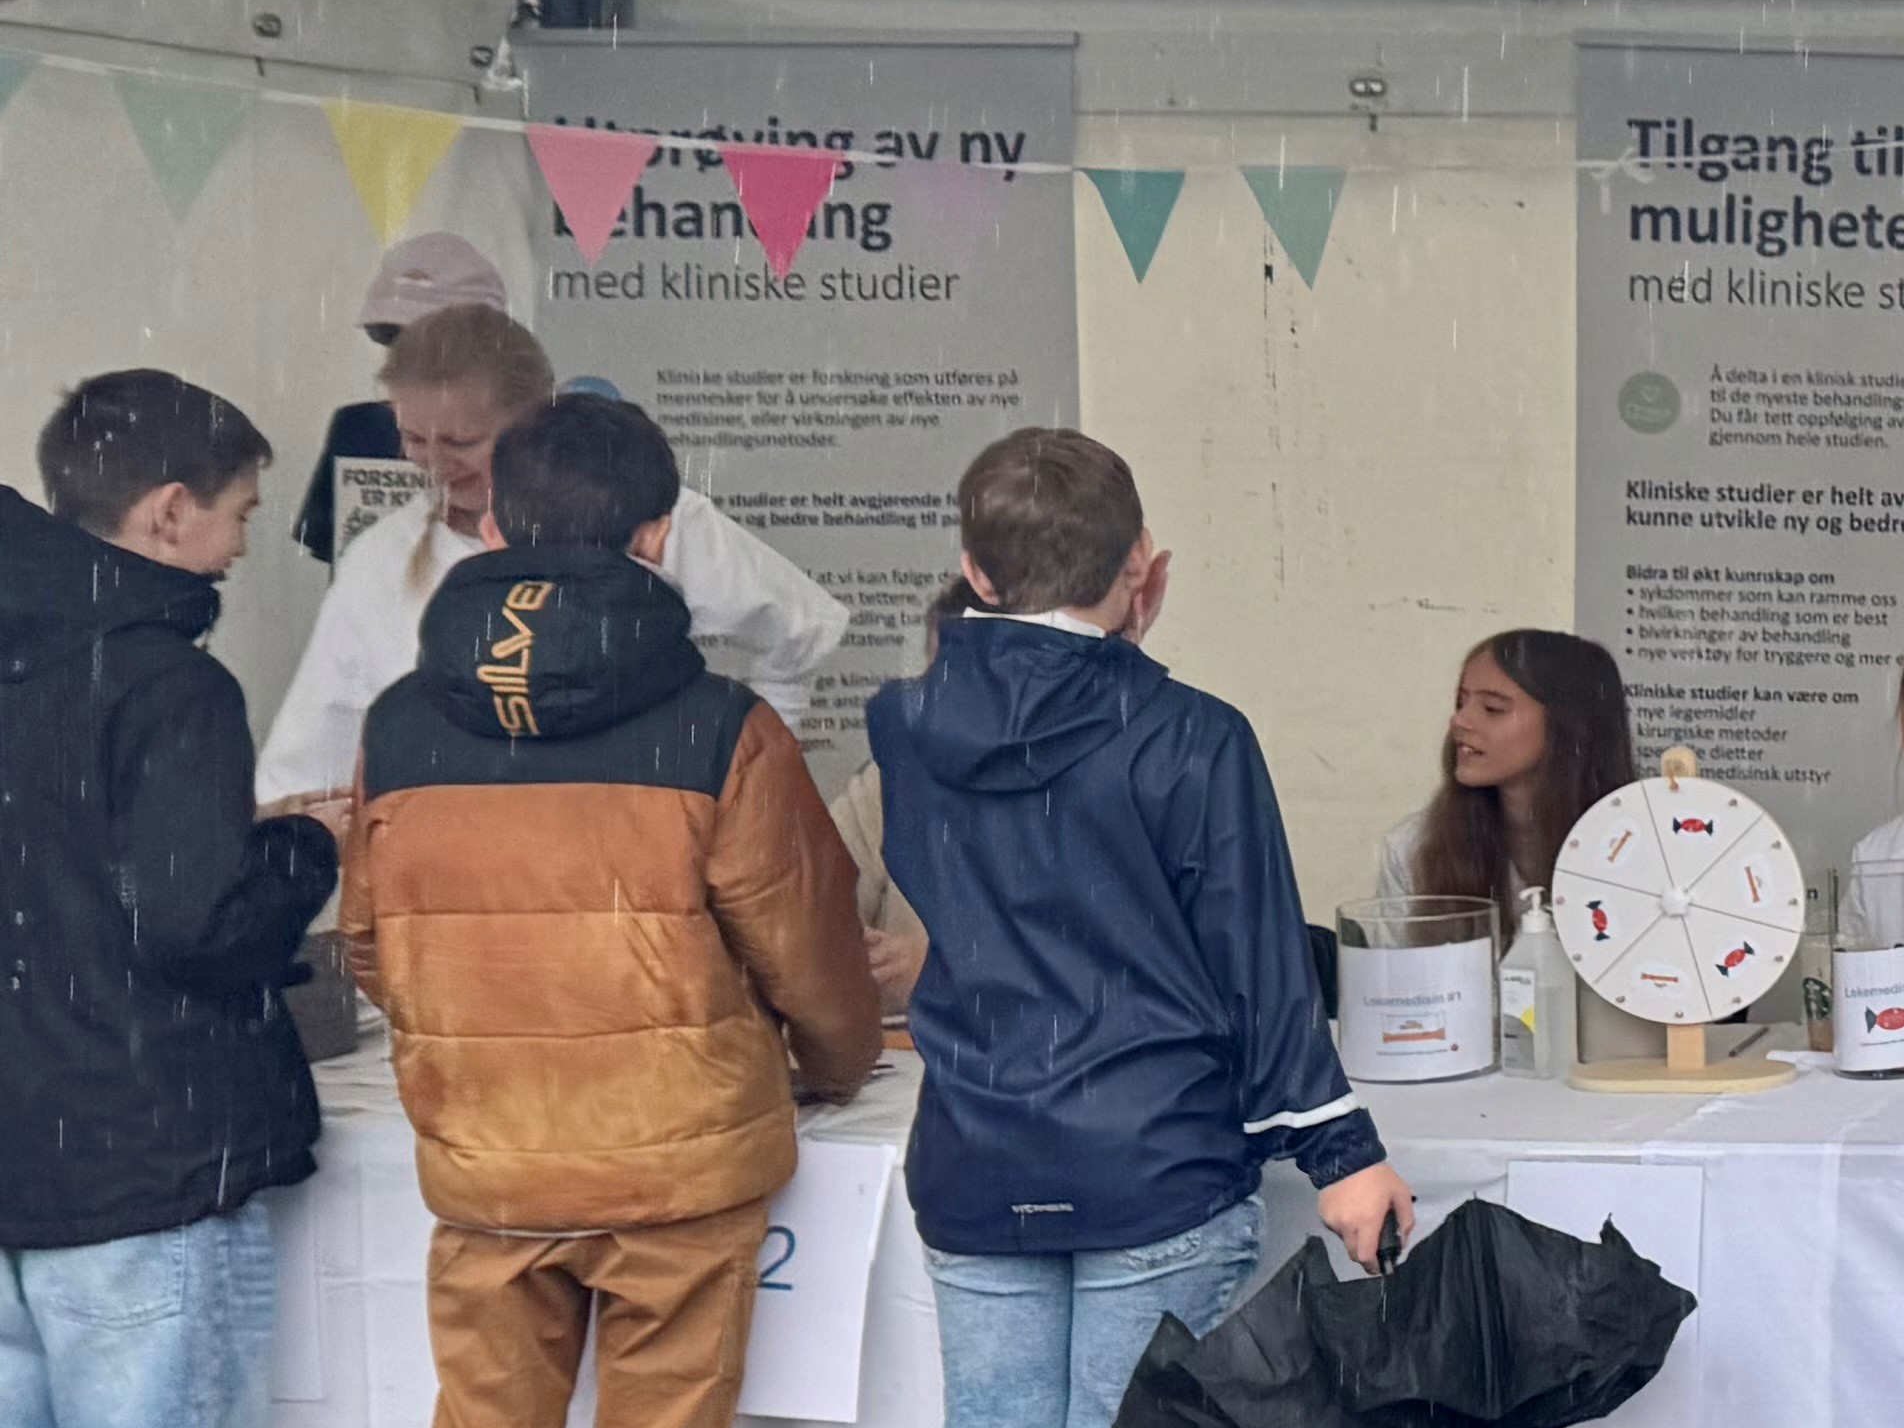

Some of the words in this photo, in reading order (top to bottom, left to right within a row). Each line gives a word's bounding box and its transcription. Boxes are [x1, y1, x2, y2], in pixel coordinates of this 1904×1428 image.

[874, 130, 940, 168] av
[961, 127, 1027, 182] ny
[1627, 117, 1835, 186] Tilgang
[1849, 127, 1904, 179] til
[552, 266, 644, 302] med
[661, 262, 806, 303] kliniske
[819, 264, 961, 303] studier
[1628, 272, 1714, 307] med
[1726, 269, 1866, 310] kliniske
[657, 370, 722, 386] Kliniske
[727, 370, 783, 386] studier
[788, 373, 805, 386] er
[813, 370, 888, 389] forskning
[894, 373, 930, 386] som
[934, 370, 994, 387] utføres
[998, 369, 1019, 389] på
[1711, 363, 1723, 383] Å
[1726, 367, 1769, 385] delta
[1782, 372, 1803, 385] en
[1807, 369, 1855, 387] klinisk
[657, 391, 751, 407] mennesker
[757, 391, 779, 406] for
[799, 392, 888, 407] undersøke
[893, 391, 961, 406] effekten
[966, 395, 984, 407] av
[1711, 388, 1730, 405] til
[1732, 389, 1752, 405] de
[1756, 392, 1808, 410] nyeste
[792, 413, 883, 429] virkningen
[1711, 407, 1733, 425] Du
[1737, 406, 1759, 425] får
[1764, 409, 1793, 426] tett
[1796, 410, 1883, 432] oppfølging
[668, 432, 838, 450] ehandlingsmetoder.
[1709, 429, 1782, 448] gjennom
[1786, 430, 1822, 448] hele
[1825, 431, 1888, 450] studien.
[728, 492, 786, 508] studier
[790, 494, 808, 508] er
[812, 491, 845, 508] helt
[850, 492, 942, 511] avgjørende
[1626, 479, 1711, 503] Kliniske
[1717, 482, 1796, 505] studier
[1801, 489, 1825, 506] er
[1831, 484, 1874, 508] helt
[770, 511, 820, 527] bedre
[823, 510, 918, 529] behandling
[1626, 505, 1694, 528] kunne
[1700, 508, 1778, 531] utvikle
[1783, 514, 1809, 536] ny
[1816, 515, 1843, 537] og
[1626, 564, 1670, 583] Bidra
[1673, 565, 1690, 582] til
[1692, 567, 1721, 584] økt
[1725, 567, 1805, 590] kunnskap
[1808, 572, 1835, 586] om
[1639, 585, 1734, 606] sykdommer
[1738, 590, 1771, 604] som
[1777, 586, 1805, 604] kan
[1810, 590, 1866, 606] ramme
[1871, 593, 1898, 607] oss
[1699, 605, 1791, 628] behandling
[1795, 608, 1828, 625] som
[1833, 612, 1851, 625] er
[1854, 610, 1889, 627] best
[1639, 624, 1734, 646] bivirkninger
[1738, 628, 1758, 641] av
[1762, 626, 1851, 649] behandling
[1639, 647, 1667, 665] nye
[1737, 646, 1758, 662] for
[1764, 649, 1832, 670] tryggere
[1834, 652, 1856, 669] og
[1858, 653, 1893, 667] mer
[1624, 683, 1685, 700] Kliniske
[1690, 685, 1748, 702] studier
[1754, 686, 1783, 702] kan
[1787, 690, 1828, 704] være
[1832, 691, 1860, 704] om
[1637, 706, 1665, 723] nye
[1669, 706, 1756, 726] legemidler
[1637, 722, 1714, 743] kirurgiske
[1718, 725, 1788, 742] metoder
[1709, 744, 1764, 761] dietter
[1784, 768, 1832, 786] utstyr
[757, 1225, 797, 1291] 2
